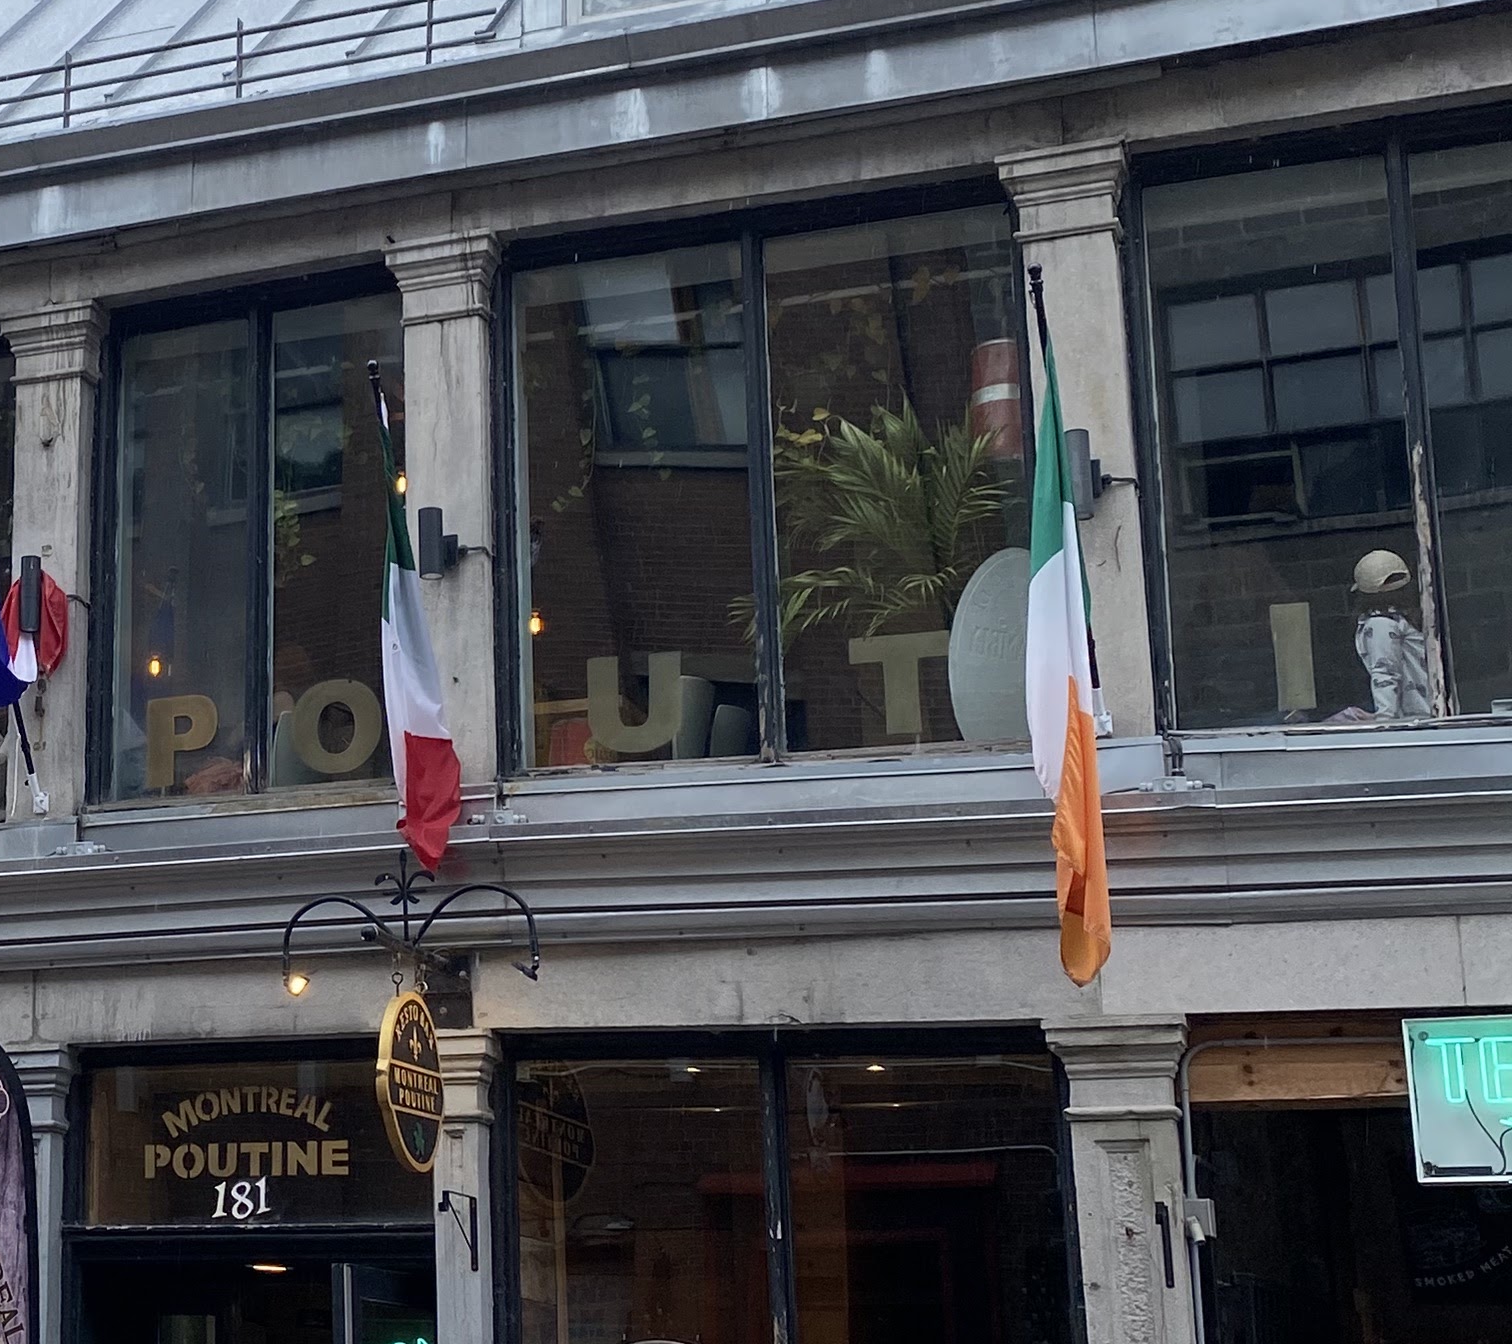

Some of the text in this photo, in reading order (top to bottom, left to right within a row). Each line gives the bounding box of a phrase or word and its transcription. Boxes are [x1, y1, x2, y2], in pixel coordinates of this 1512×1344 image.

[395, 1004, 418, 1043] RESTO
[393, 1067, 440, 1096] MONTREAL
[399, 1088, 437, 1114] POUTINE
[161, 1085, 333, 1139] MONTREAL
[144, 1139, 349, 1179] POUTINE
[211, 1175, 272, 1220] 181
[1414, 1270, 1475, 1288] SMOKED
